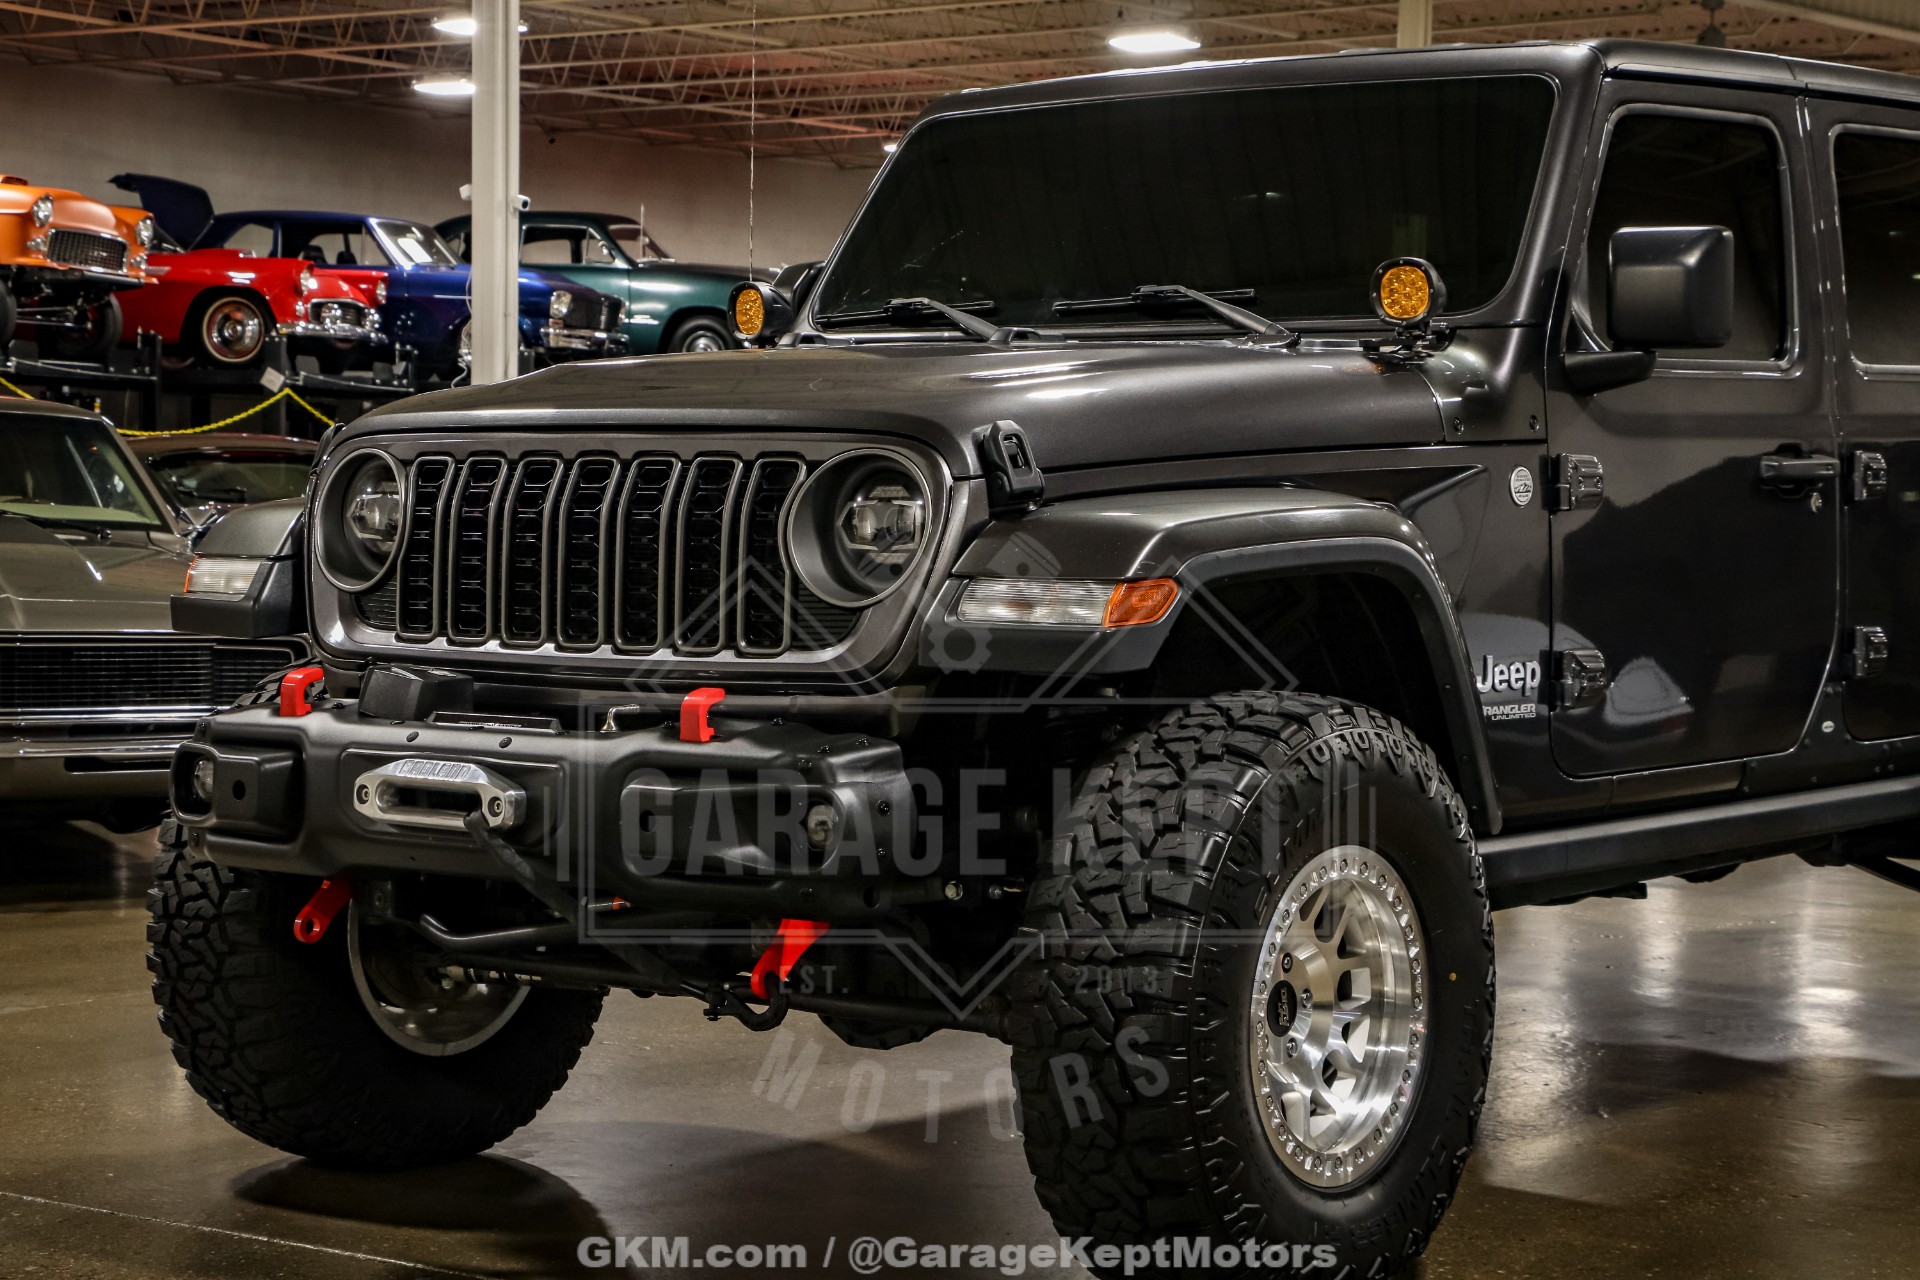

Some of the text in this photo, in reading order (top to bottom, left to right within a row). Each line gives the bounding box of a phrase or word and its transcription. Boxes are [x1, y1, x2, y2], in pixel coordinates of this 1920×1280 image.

[1476, 655, 1541, 697] Jeep
[1491, 712, 1536, 721] UNLIMITED
[397, 759, 472, 781] BADLAND
